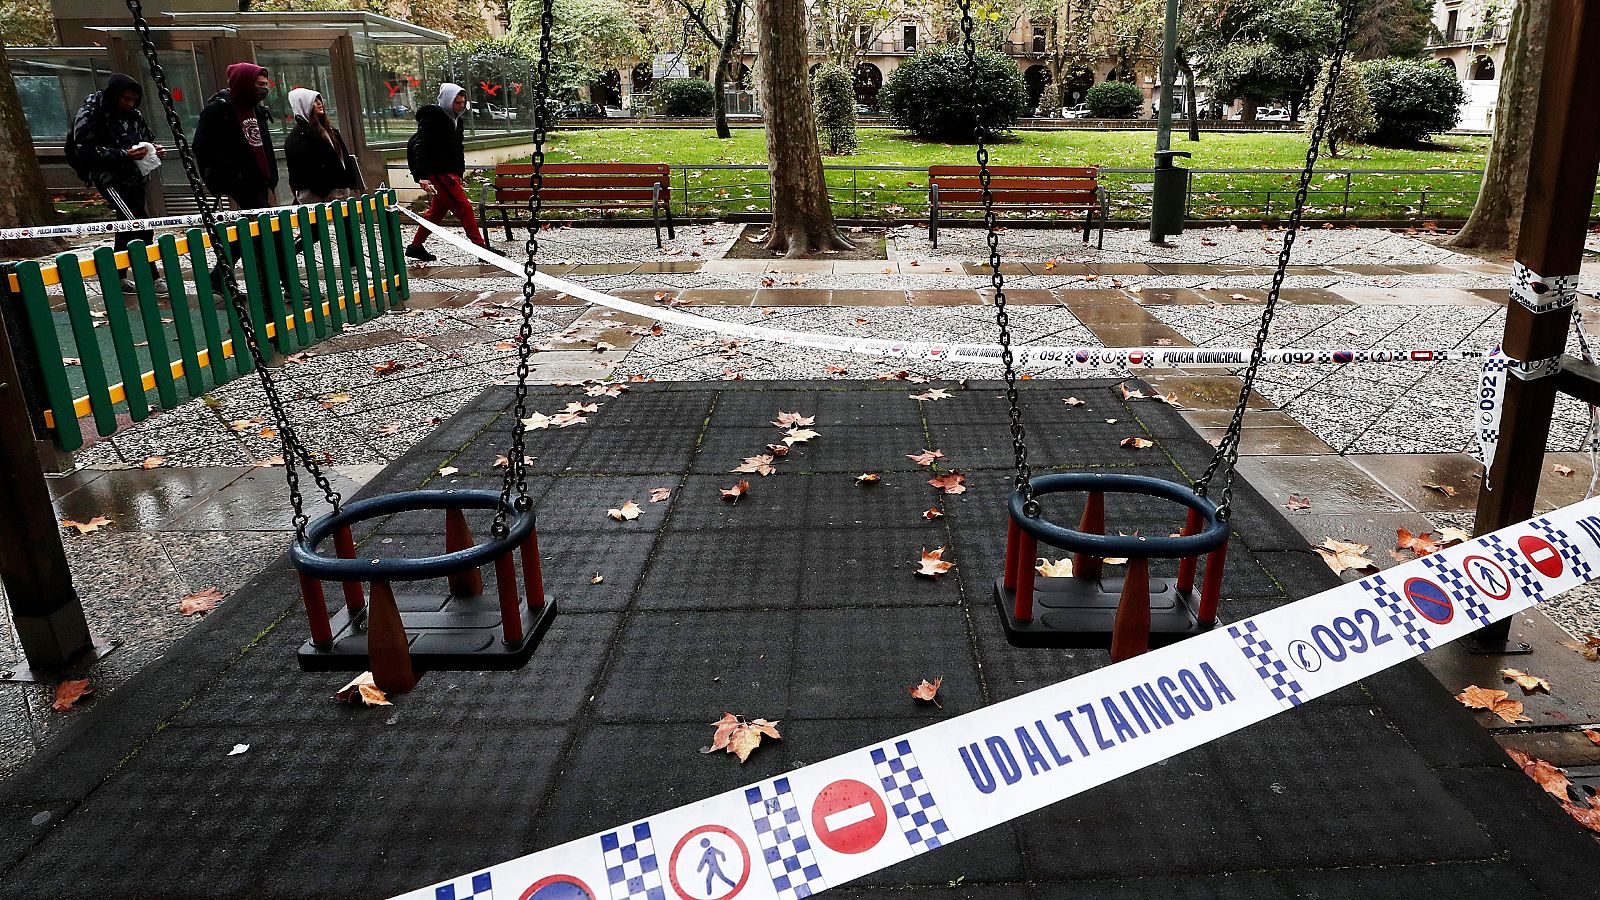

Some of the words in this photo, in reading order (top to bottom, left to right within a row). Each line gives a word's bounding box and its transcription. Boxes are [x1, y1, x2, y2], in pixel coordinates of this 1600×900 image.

[1040, 350, 1063, 361] 092
[1163, 351, 1195, 363] POLICIA
[1196, 351, 1248, 364] MUNICIPAL
[1282, 352, 1315, 364] 092
[1480, 376, 1497, 411] 092
[1311, 608, 1394, 663] 092
[958, 661, 1237, 795] UDALTZAINGOA
